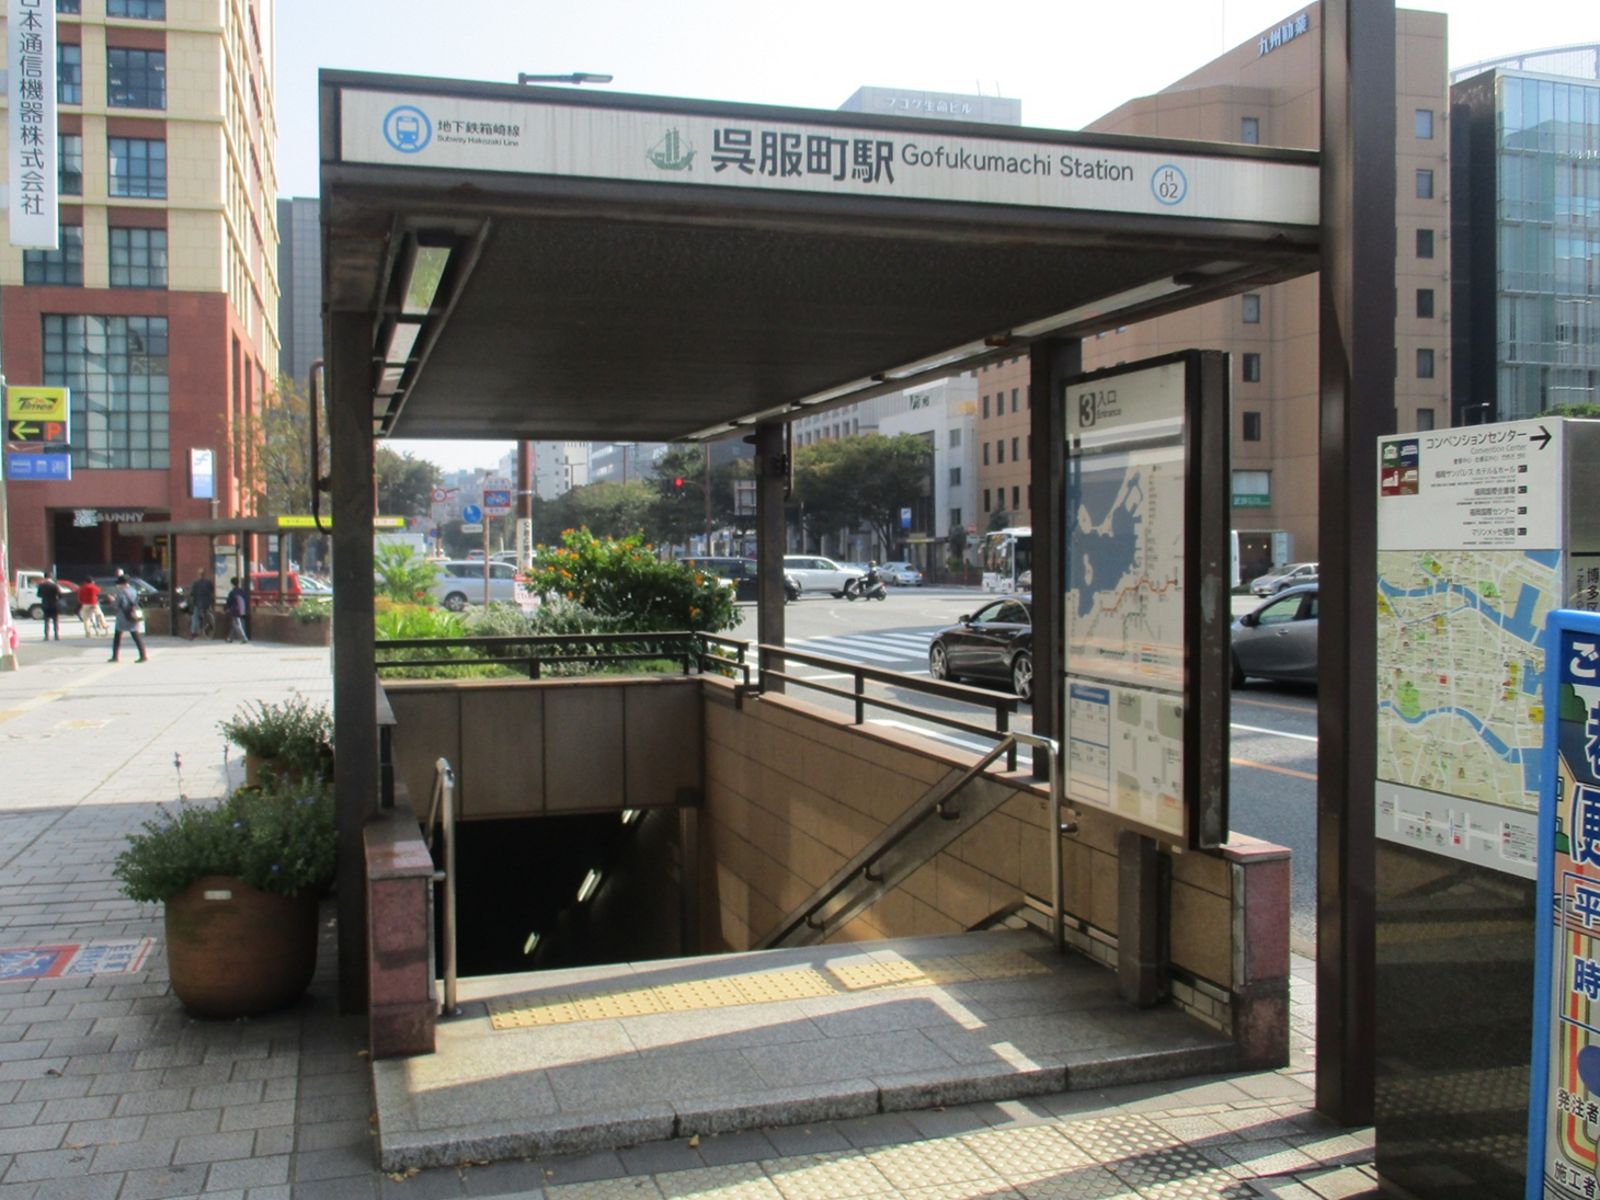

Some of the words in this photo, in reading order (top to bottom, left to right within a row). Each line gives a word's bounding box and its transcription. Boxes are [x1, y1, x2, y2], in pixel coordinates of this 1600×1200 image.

[19, 0, 44, 215] 本通信機器株式会社
[437, 134, 466, 145] Subway
[468, 137, 501, 146] Hakozaki
[503, 139, 519, 147] Line
[711, 128, 895, 184] 呉服町駅
[901, 143, 1051, 175] Gofukumachi
[1059, 155, 1134, 182] Station
[1164, 170, 1174, 182] H
[1159, 183, 1179, 199] 02
[1081, 394, 1094, 427] 3
[1097, 390, 1117, 407] 入口
[47, 422, 62, 440] P
[1426, 429, 1527, 449] コンベンションセンター
[1558, 1089, 1600, 1125] 発注者
[1554, 1161, 1597, 1199] 施工者
